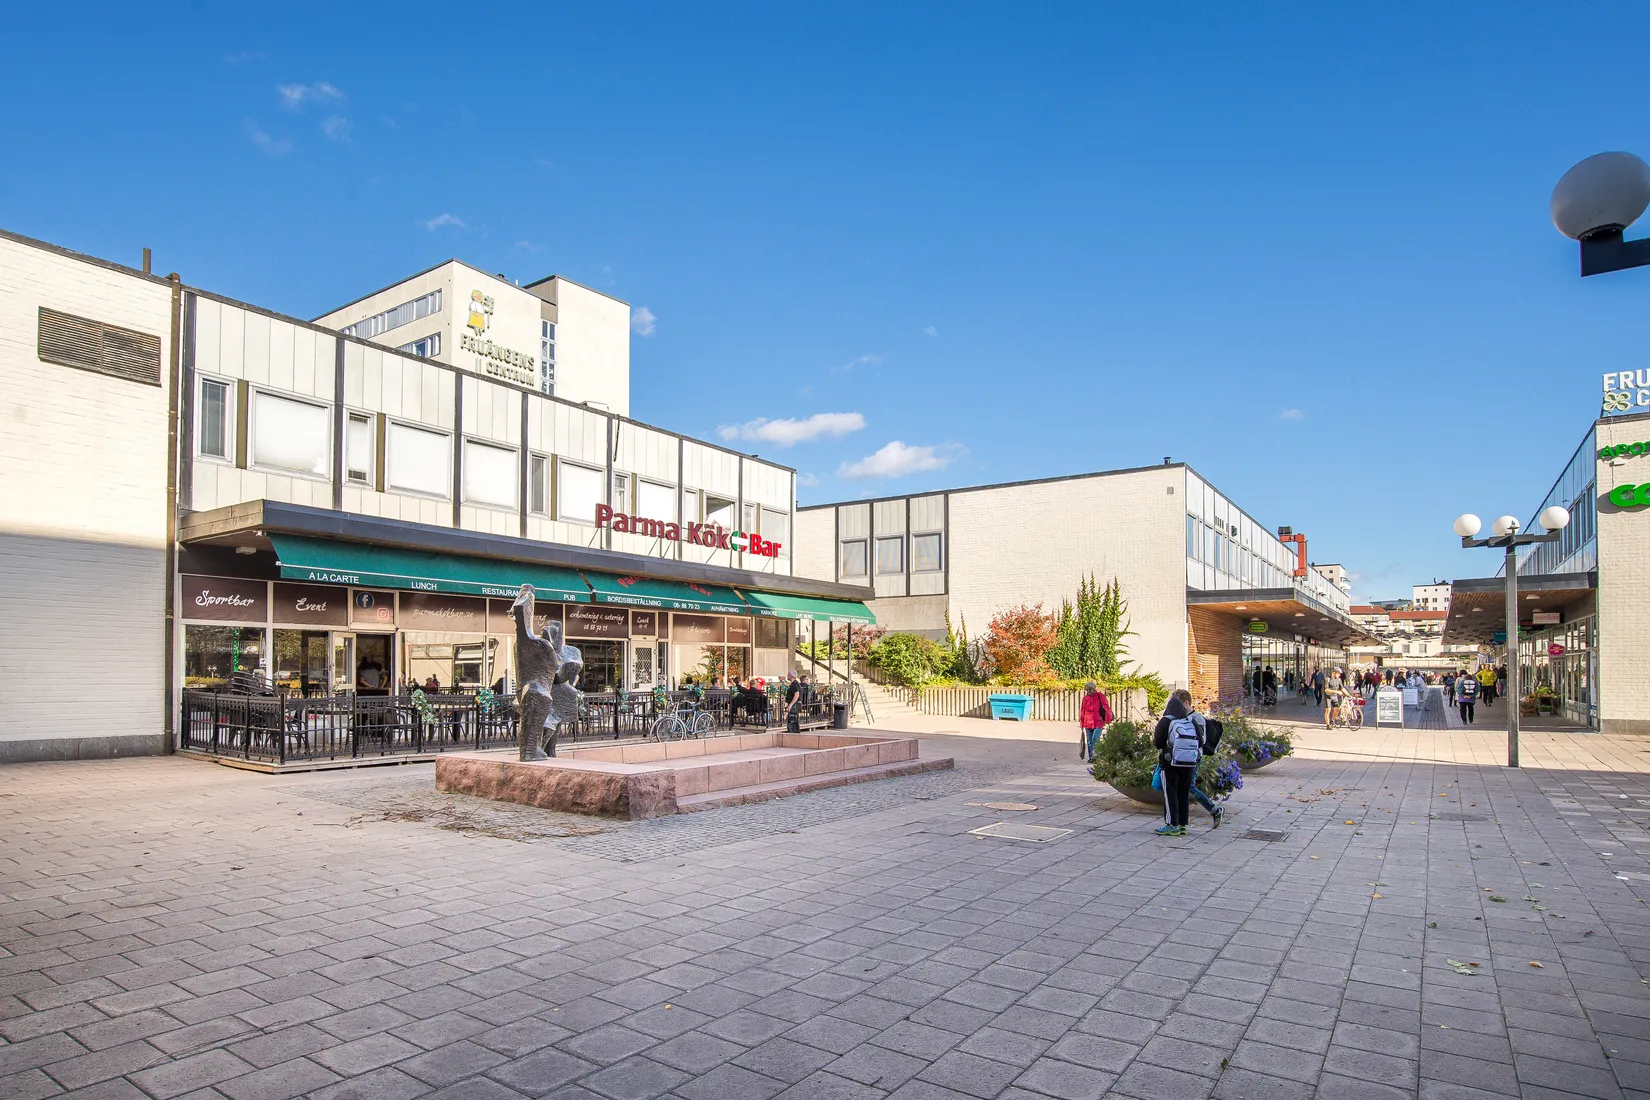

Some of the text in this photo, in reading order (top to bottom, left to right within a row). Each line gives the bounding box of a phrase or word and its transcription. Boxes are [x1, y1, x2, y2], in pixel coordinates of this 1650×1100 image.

[460, 332, 534, 372] FRUÄNGENS
[486, 361, 534, 387] CENTRUM
[595, 503, 782, 559] Parma Kök Bar
[317, 573, 328, 581] LA
[329, 574, 360, 584] CARTE
[411, 582, 437, 591] LUNCH
[482, 587, 521, 597] RESTAURAN
[195, 590, 254, 607] Sportbar
[295, 598, 327, 611] Event
[607, 595, 662, 607] BORDSBESTÄLLNING
[604, 614, 625, 625] catering
